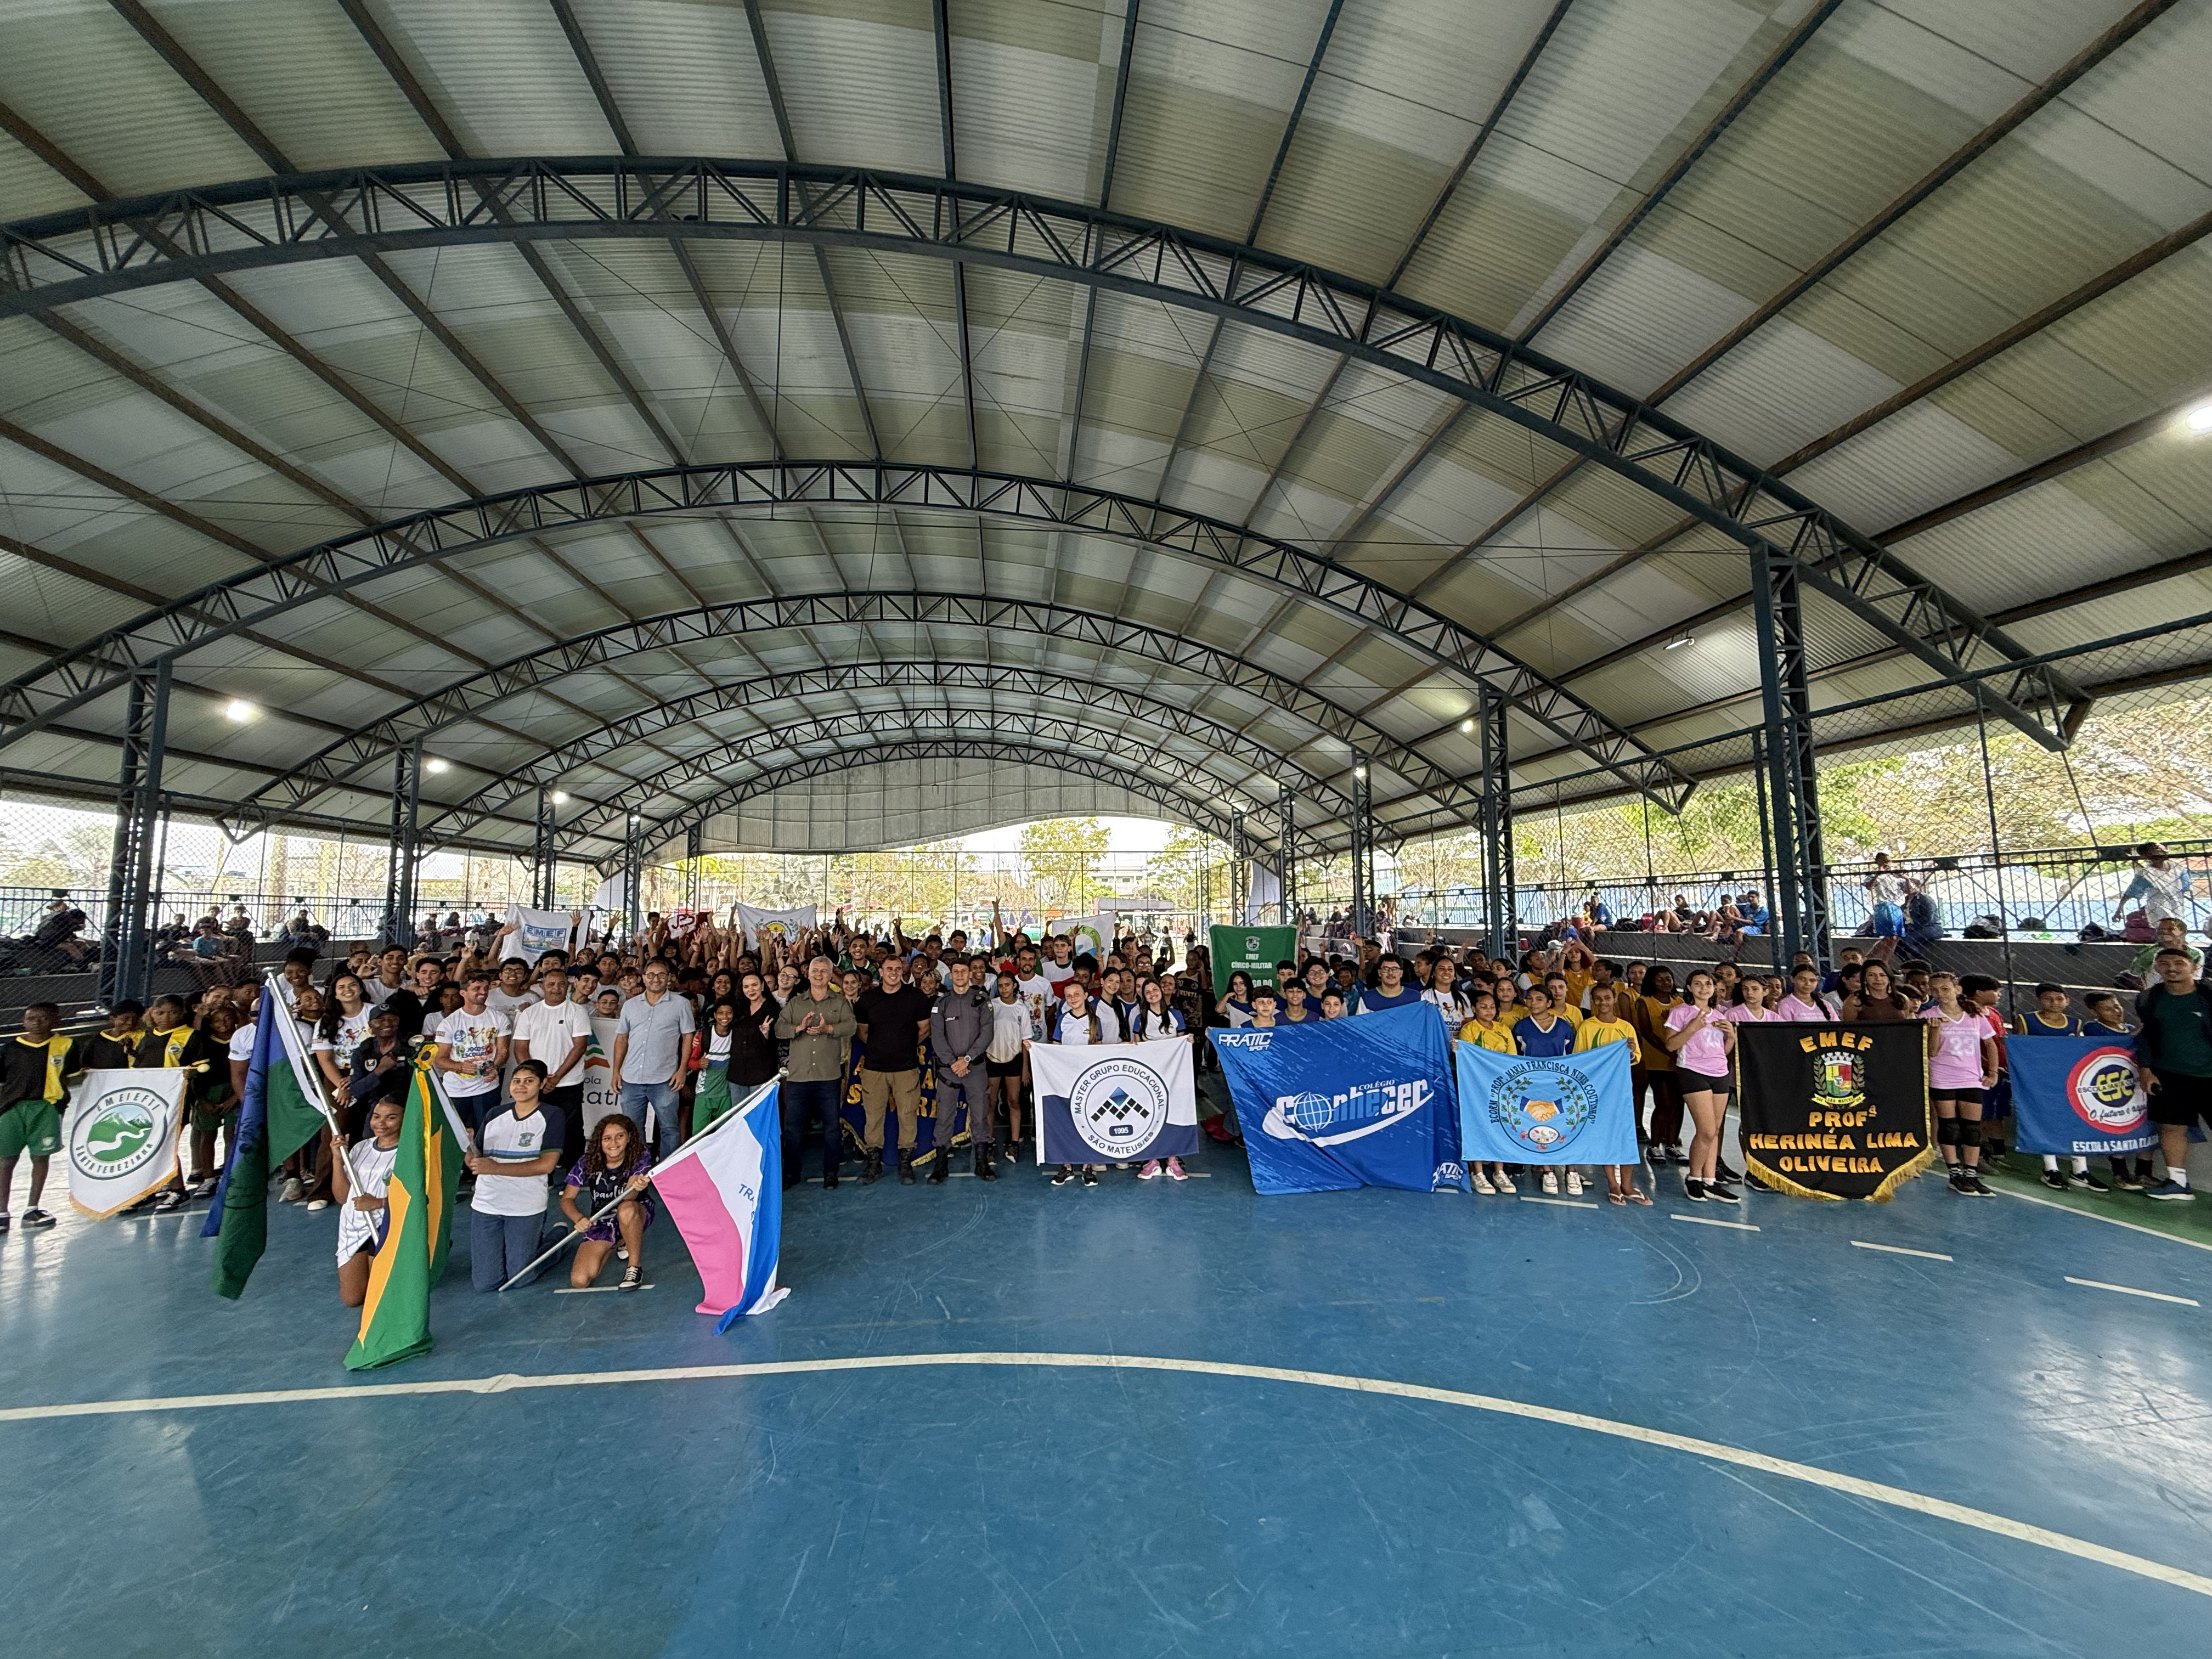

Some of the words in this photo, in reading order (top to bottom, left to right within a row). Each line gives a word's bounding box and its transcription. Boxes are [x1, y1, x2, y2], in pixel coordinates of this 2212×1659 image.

[526, 927, 565, 937] EMEF
[1218, 1032, 1273, 1047] PRATIC
[1799, 1031, 1873, 1053] EMEF
[584, 1076, 601, 1085] ola
[1075, 1079, 1091, 1114] MASTER
[1090, 1064, 1120, 1081] GRUPO
[1122, 1064, 1165, 1110] EDUCACIONAL
[1358, 1079, 1395, 1090] COLÉGIO
[1489, 1101, 1499, 1124] ECORM
[1505, 1063, 1527, 1080] MARIA
[1526, 1060, 1570, 1074] FRANCISCA
[1570, 1068, 1590, 1086] NUNES
[1088, 1135, 1105, 1149] SÃO
[1107, 1131, 1154, 1154] MATEUS/ES
[1749, 1127, 1856, 1150] HERINÉA
[1866, 1132, 1920, 1149] LIMA
[2072, 1141, 2110, 1153] ESCOLA
[2110, 1139, 2138, 1152] SANTA
[1779, 1155, 1884, 1173] OLIVEIRA
